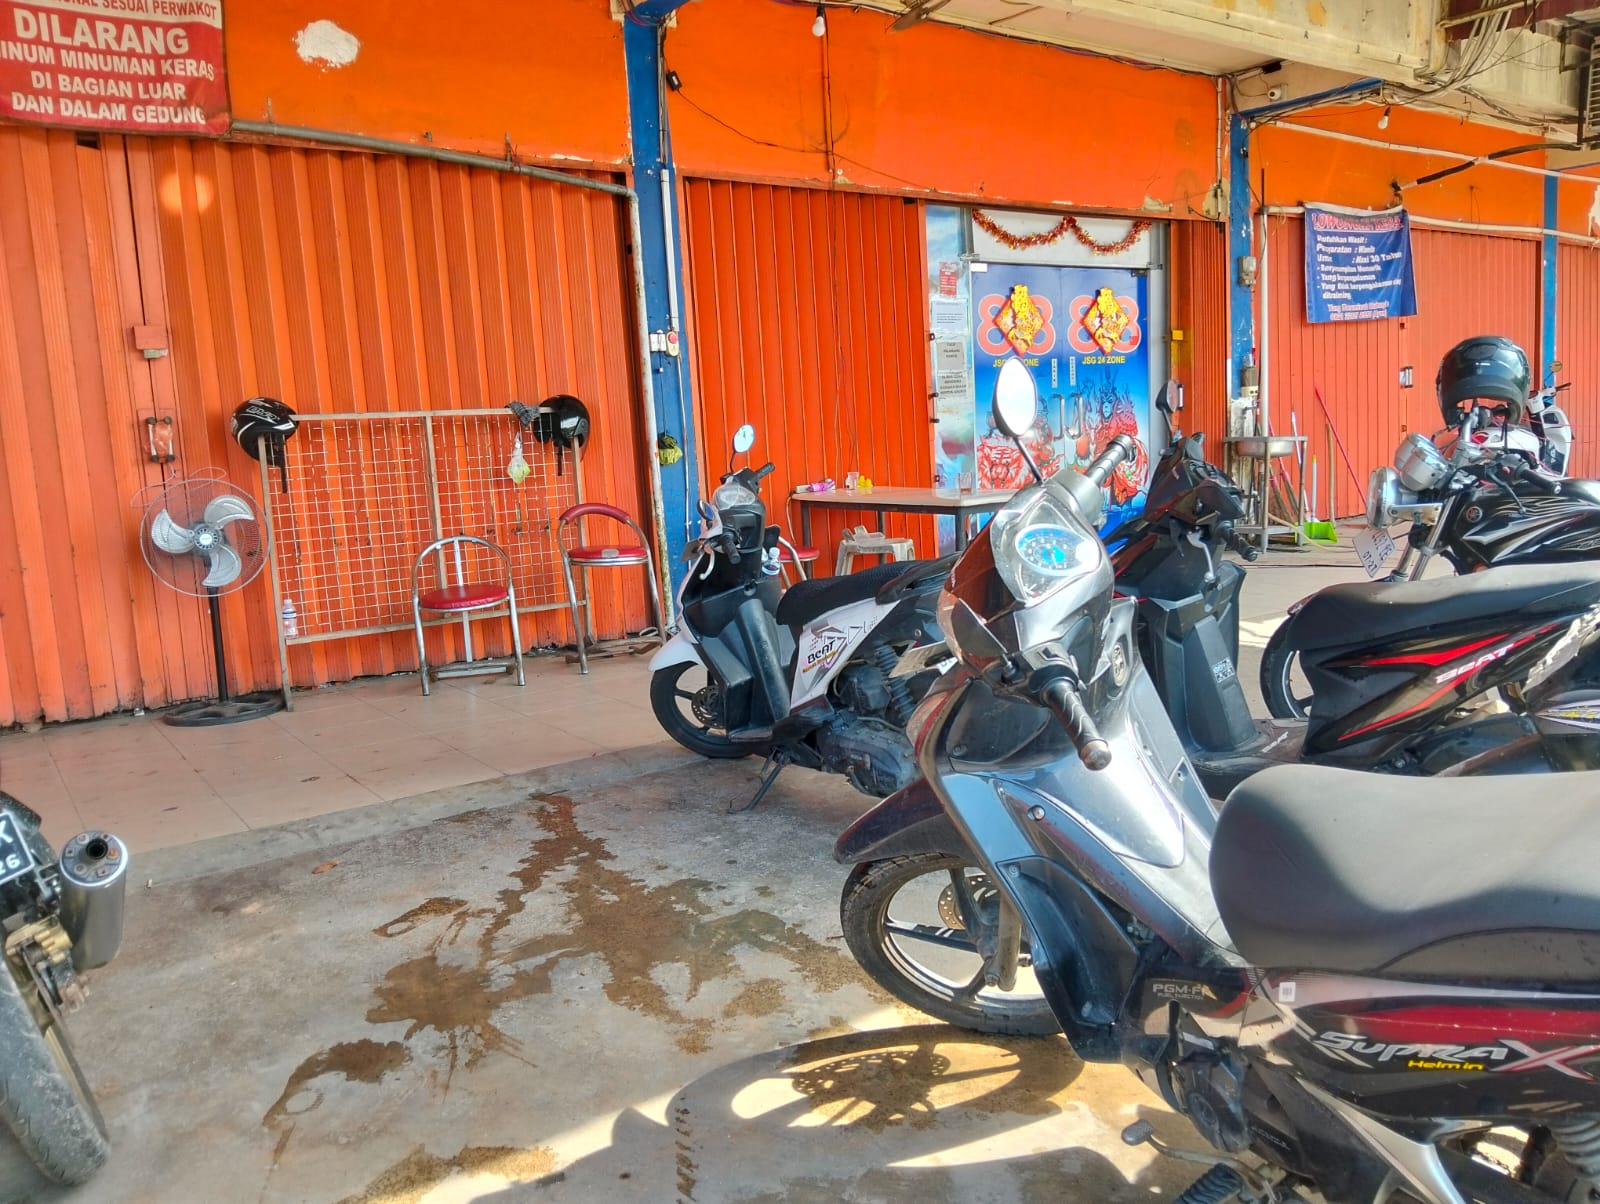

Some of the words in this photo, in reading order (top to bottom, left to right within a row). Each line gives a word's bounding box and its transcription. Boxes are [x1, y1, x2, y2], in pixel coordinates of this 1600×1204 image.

[102, 0, 149, 13] SESUAI
[13, 8, 189, 55] DILARANG
[0, 40, 55, 64] INUM
[61, 48, 156, 76] MINUMAN
[161, 58, 215, 81] KERAS
[31, 70, 52, 89] DI
[57, 73, 133, 98] BAGIAN
[138, 82, 187, 101] LUAR
[12, 91, 54, 114] DAN
[60, 99, 127, 121] DALAM
[132, 105, 206, 125] GEDUNG
[1024, 358, 1039, 366] ONE
[1082, 357, 1096, 365] JSG
[1107, 356, 1126, 364] ZONE
